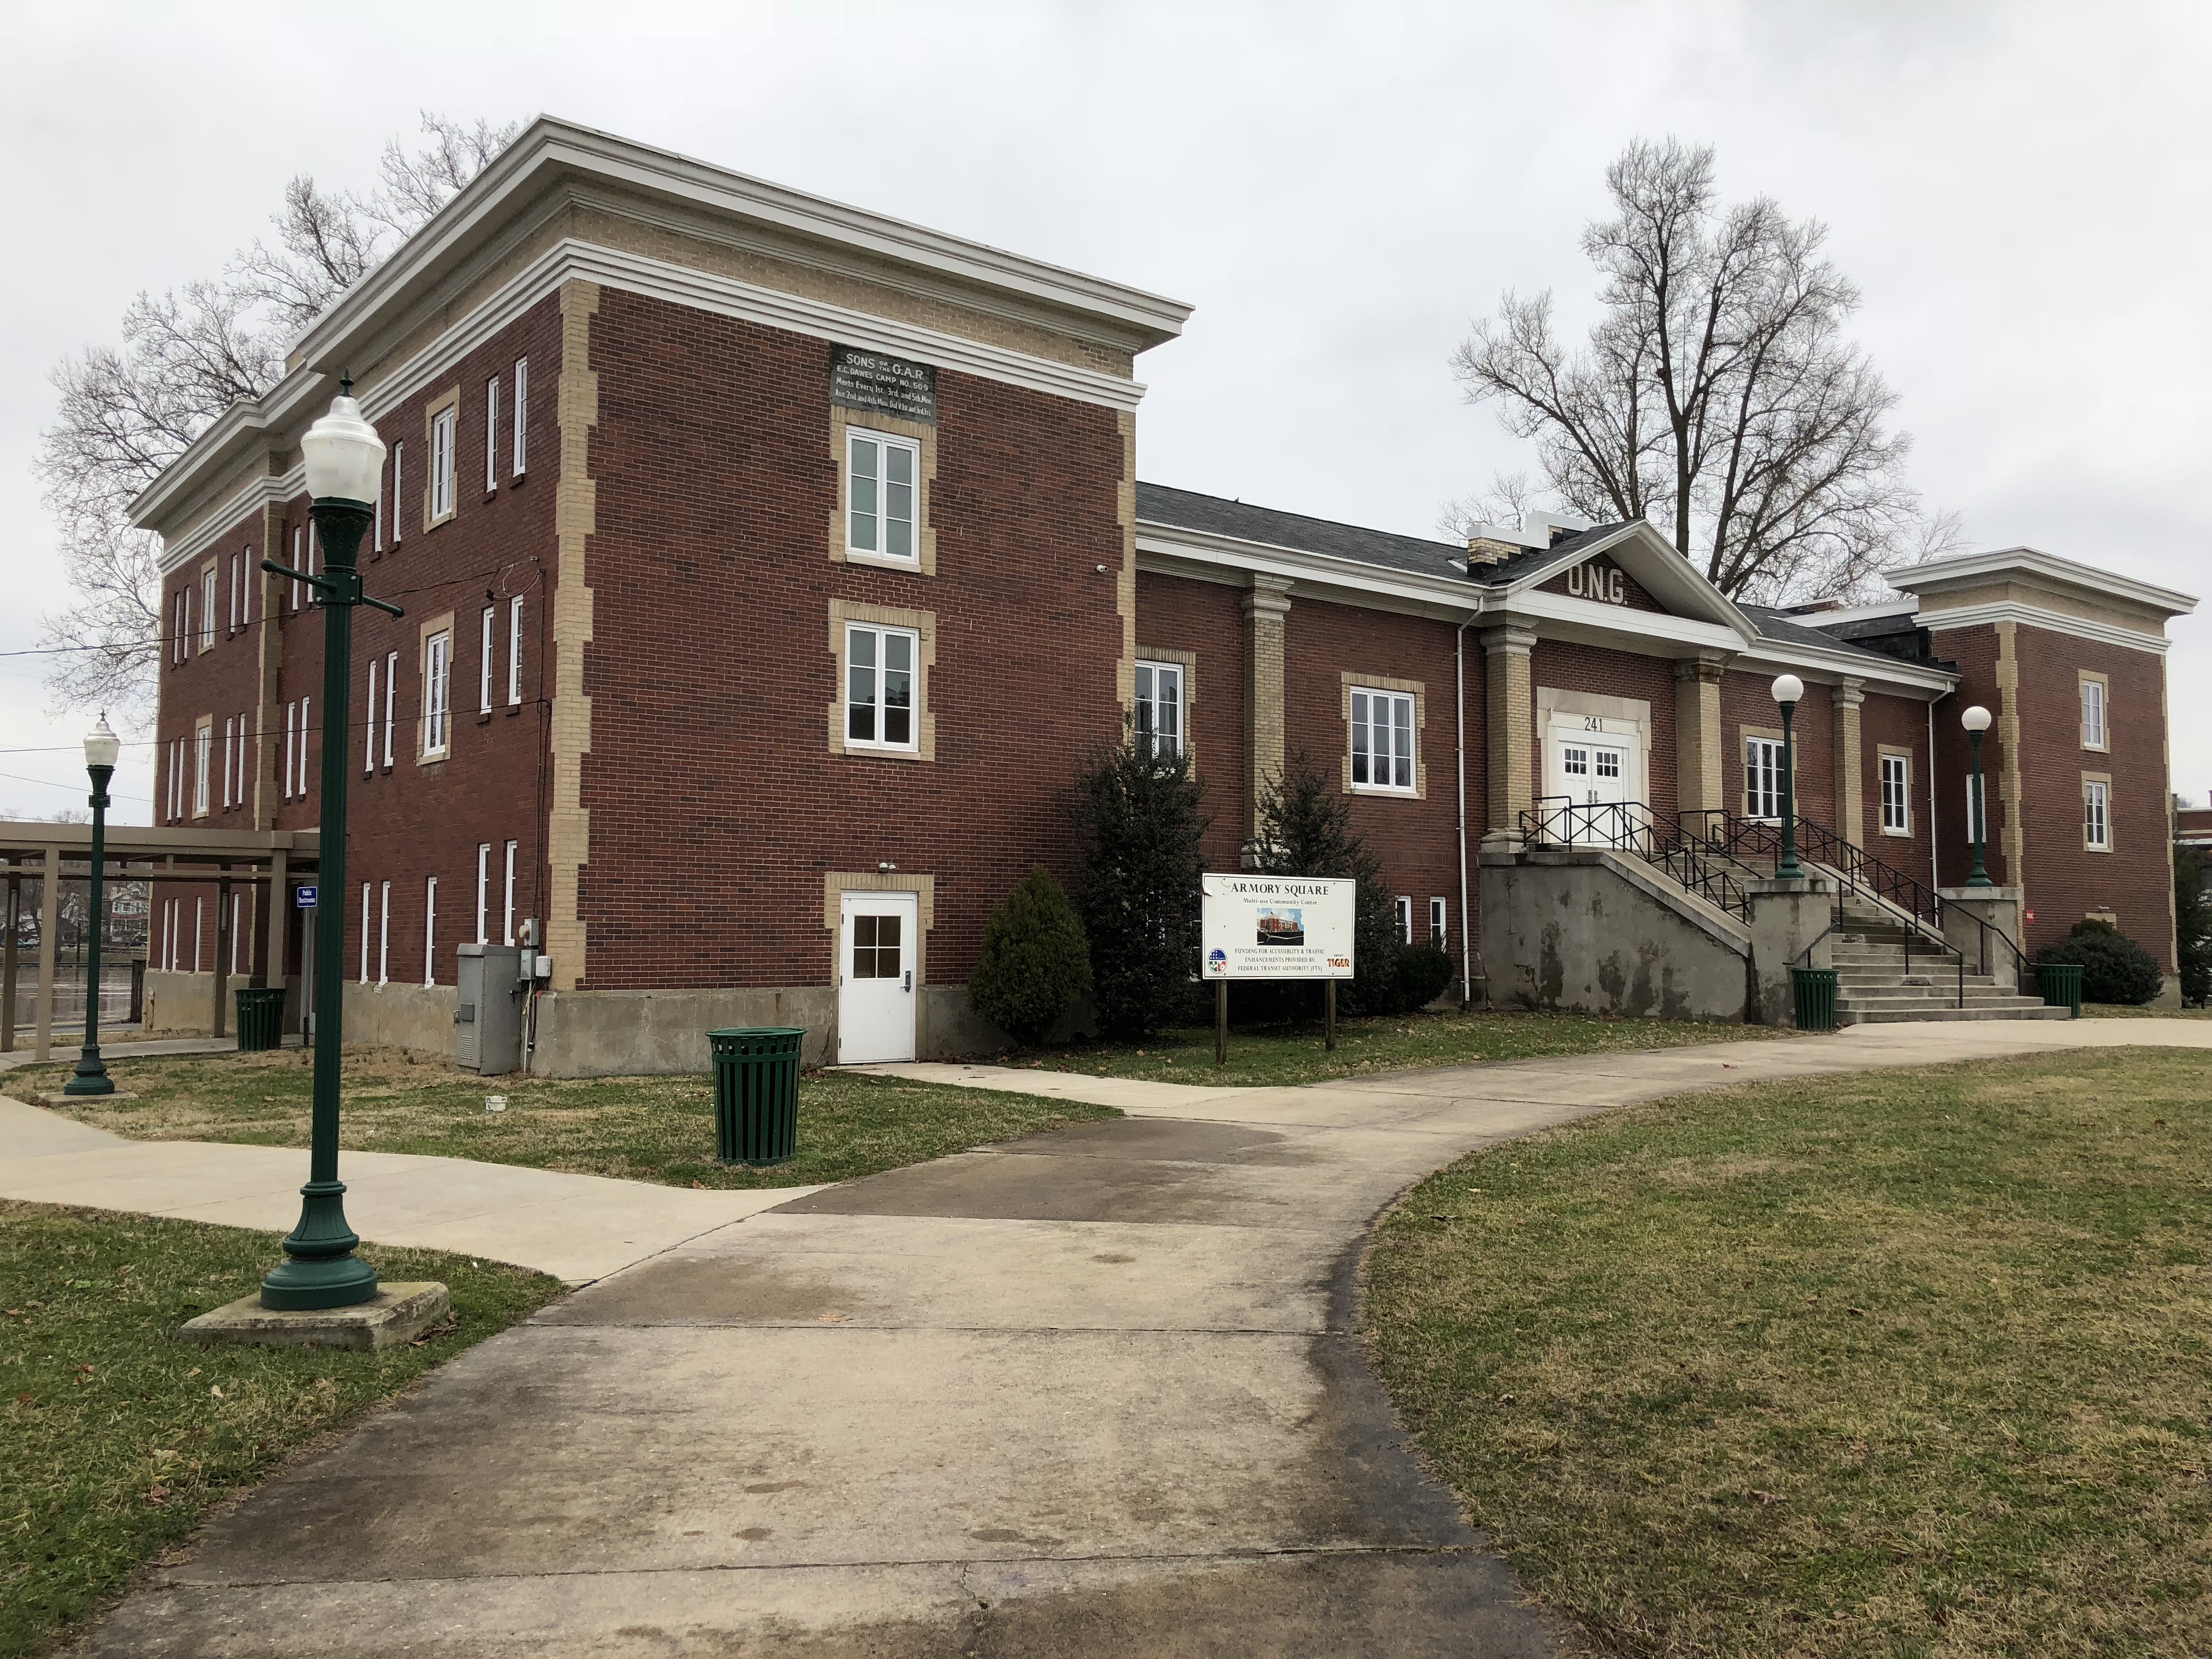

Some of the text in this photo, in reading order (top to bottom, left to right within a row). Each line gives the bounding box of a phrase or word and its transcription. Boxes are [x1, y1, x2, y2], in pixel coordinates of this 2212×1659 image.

[846, 353, 875, 369] SONS
[892, 364, 924, 380] G.A.R.
[836, 376, 854, 387] Meets
[856, 380, 873, 393] Every
[876, 373, 896, 383] CAMP
[900, 379, 911, 387] NO.
[913, 382, 928, 391] 509
[1585, 717, 1602, 732] 241
[1231, 883, 1329, 898] ARMORY SQUARE
[1327, 958, 1350, 967] TIGER
